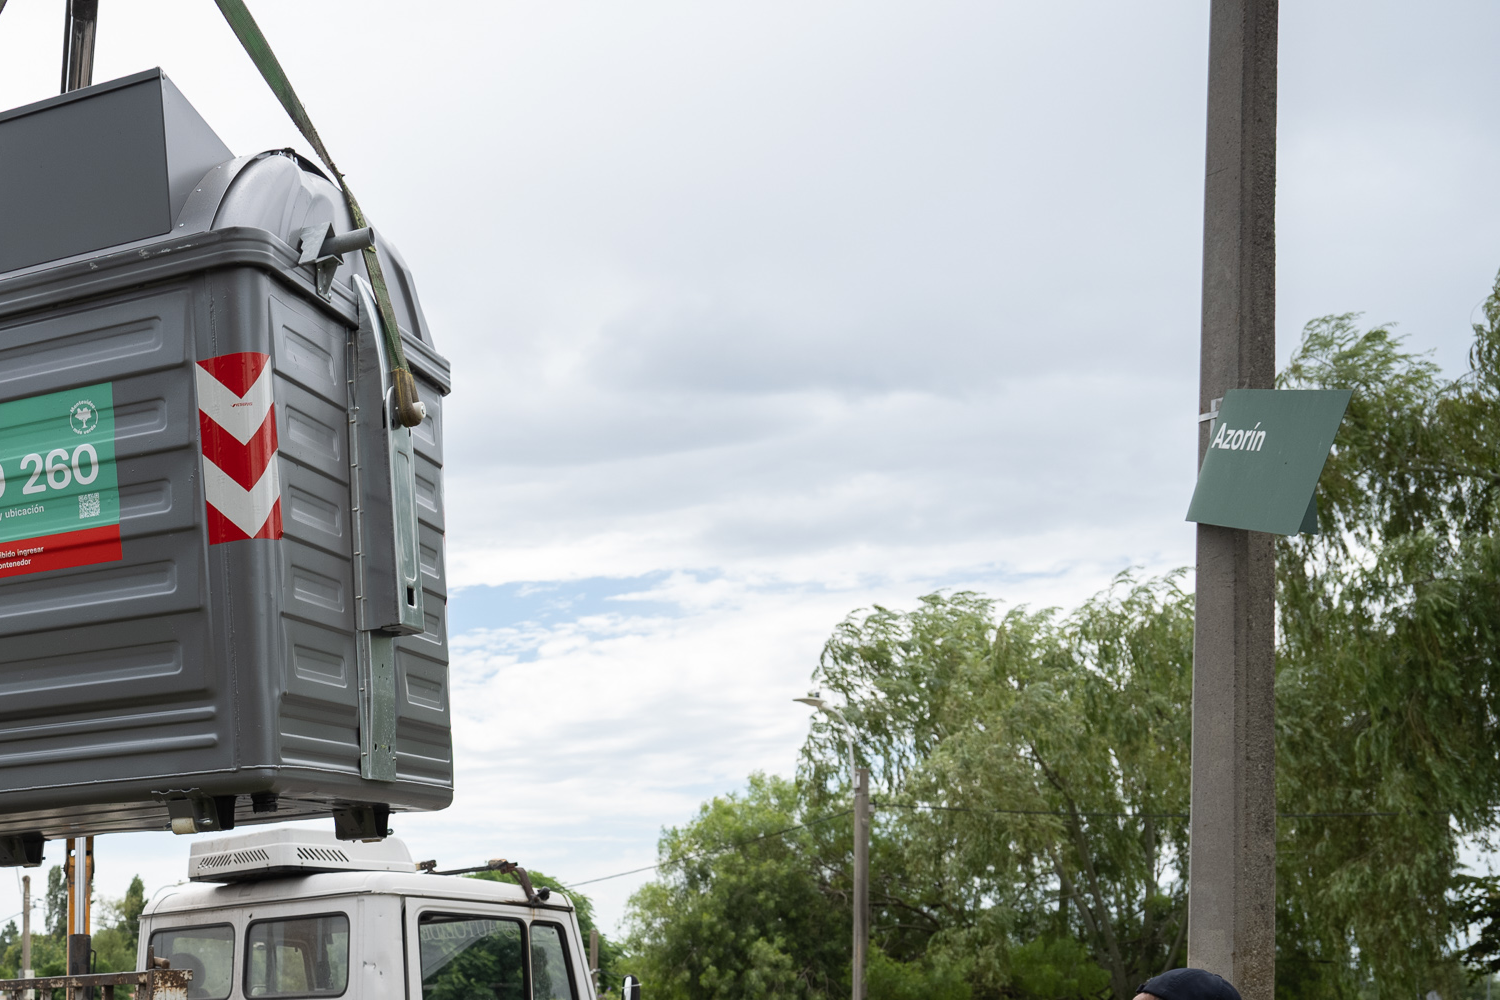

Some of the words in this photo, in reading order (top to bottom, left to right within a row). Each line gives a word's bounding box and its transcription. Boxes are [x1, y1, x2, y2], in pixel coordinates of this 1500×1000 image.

[1211, 422, 1267, 452] Azorín
[20, 443, 98, 494] 260
[5, 504, 44, 518] ubicación
[17, 547, 44, 556] ingresar
